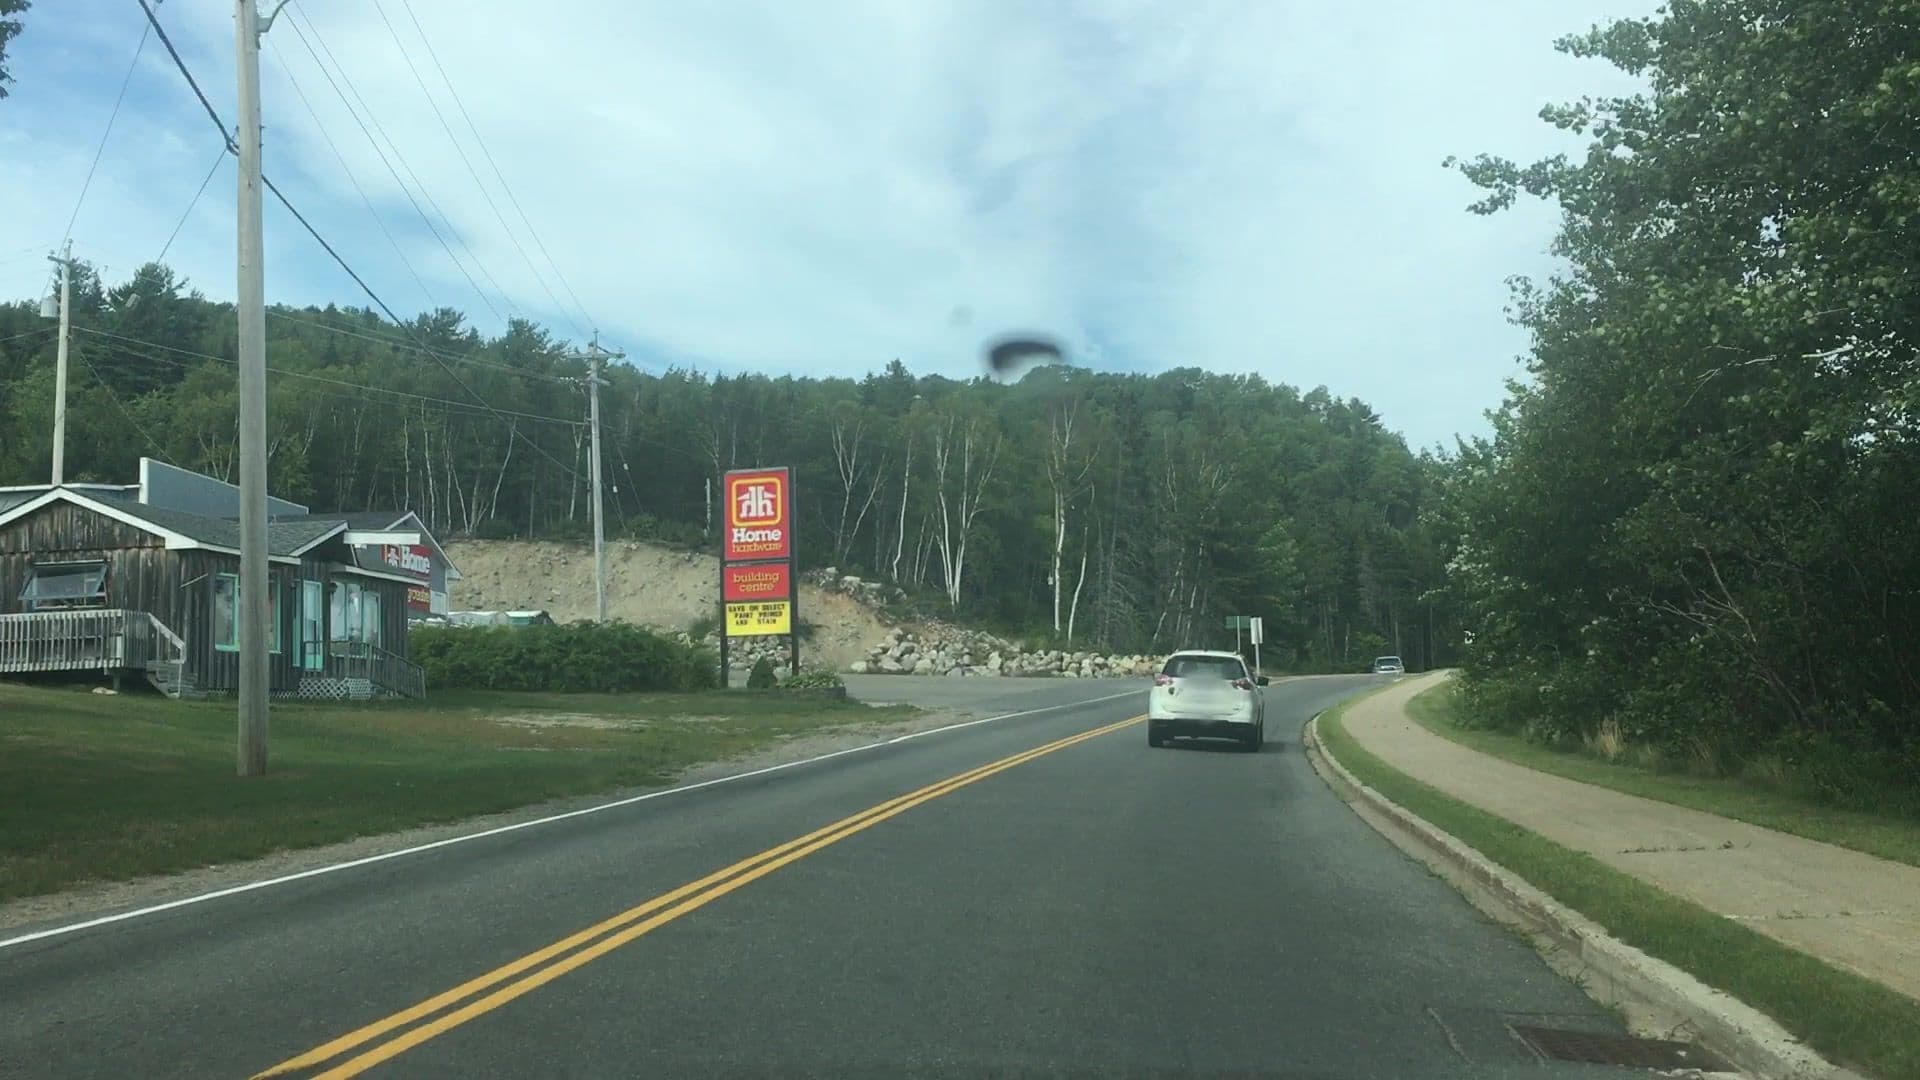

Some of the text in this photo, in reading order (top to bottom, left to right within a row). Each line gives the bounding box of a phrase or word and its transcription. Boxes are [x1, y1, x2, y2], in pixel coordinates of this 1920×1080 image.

[732, 528, 782, 543] Home
[733, 542, 782, 552] hardware
[402, 546, 430, 574] Home
[734, 572, 780, 584] building
[739, 582, 775, 593] centre
[762, 603, 785, 611] SELECT
